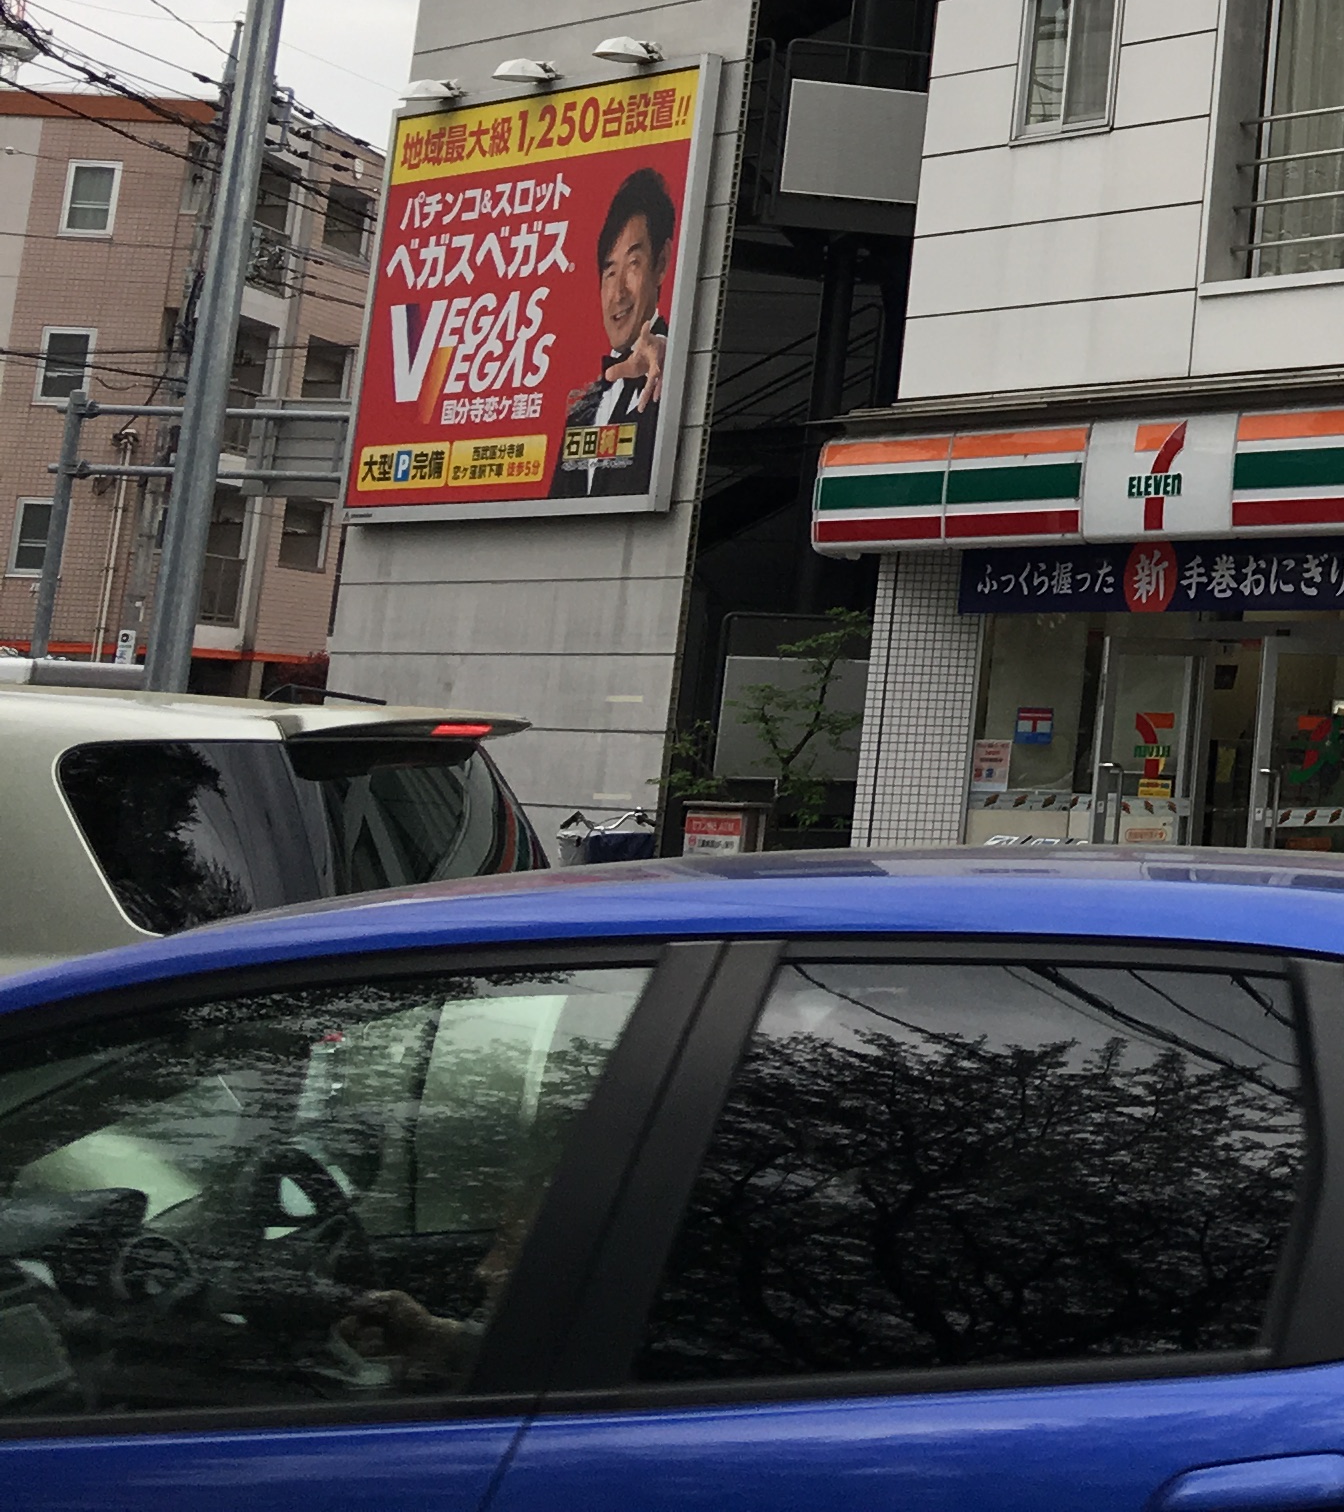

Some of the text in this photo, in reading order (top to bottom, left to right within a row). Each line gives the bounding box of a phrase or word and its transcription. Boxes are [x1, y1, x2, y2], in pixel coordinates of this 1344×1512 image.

[400, 173, 571, 231] パチンコ&スロット
[1134, 419, 1188, 531] 7
[976, 561, 1116, 597] ふっくら握った
[1131, 549, 1170, 604] 新
